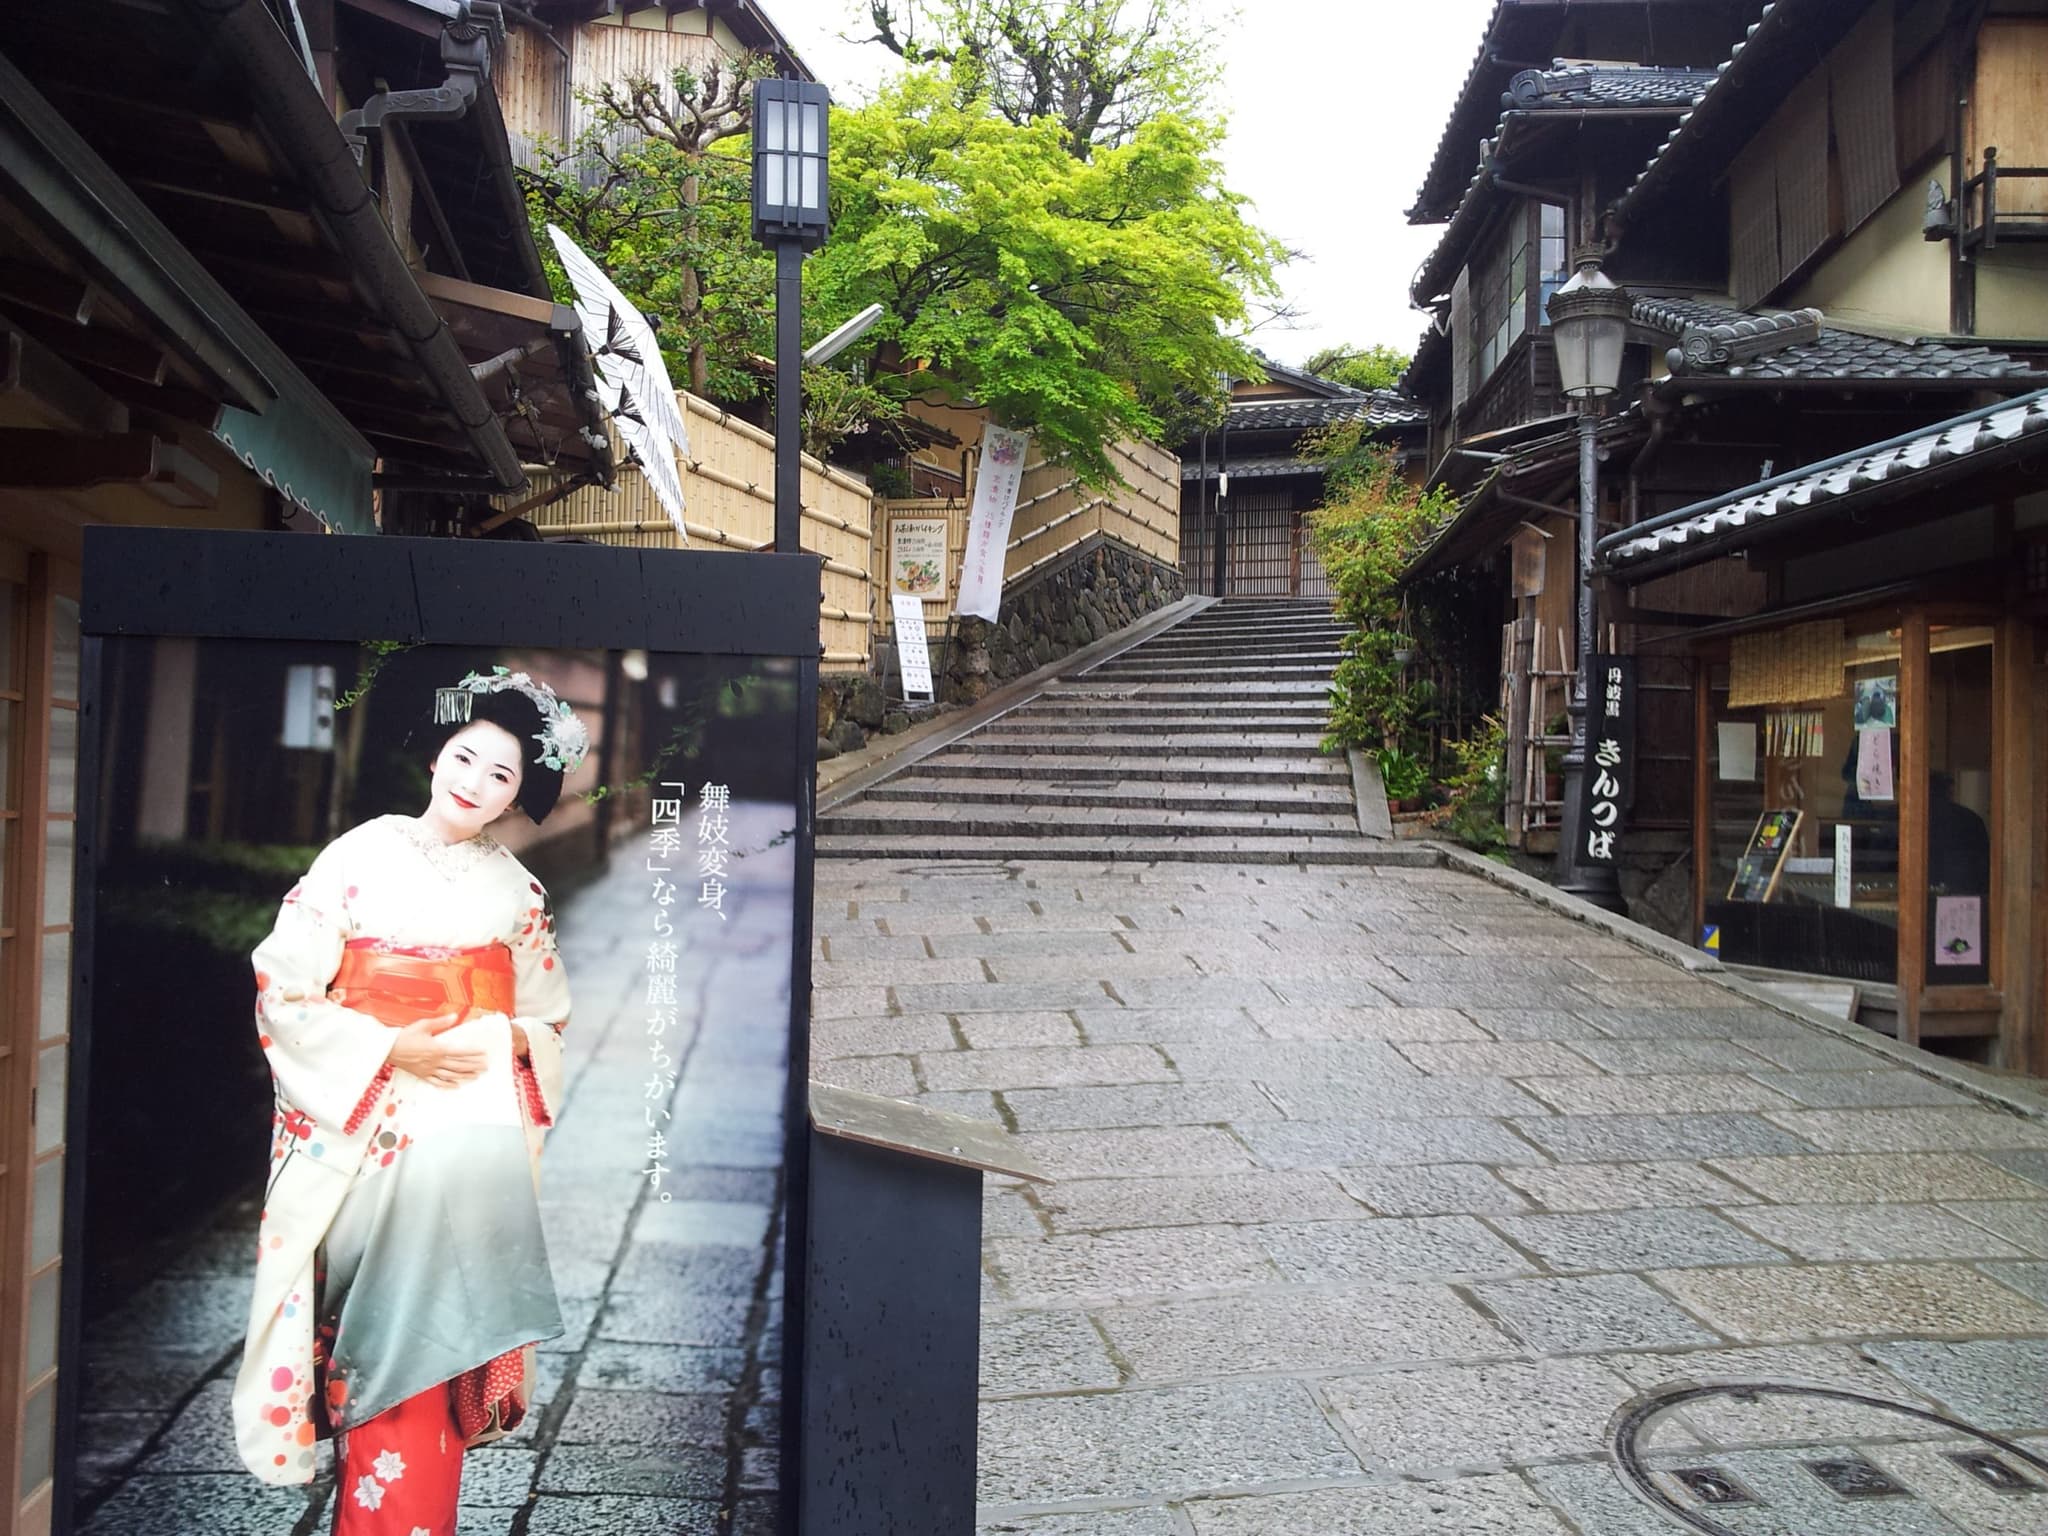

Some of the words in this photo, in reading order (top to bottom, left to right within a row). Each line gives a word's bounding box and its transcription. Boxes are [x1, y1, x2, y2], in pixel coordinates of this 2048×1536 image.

[1605, 666, 1623, 718] 丹波黒
[698, 780, 731, 921] 舞妓変身、
[1587, 737, 1622, 860] きんつば
[642, 781, 685, 1204] 「四季」なら綺麗がちがいます。
